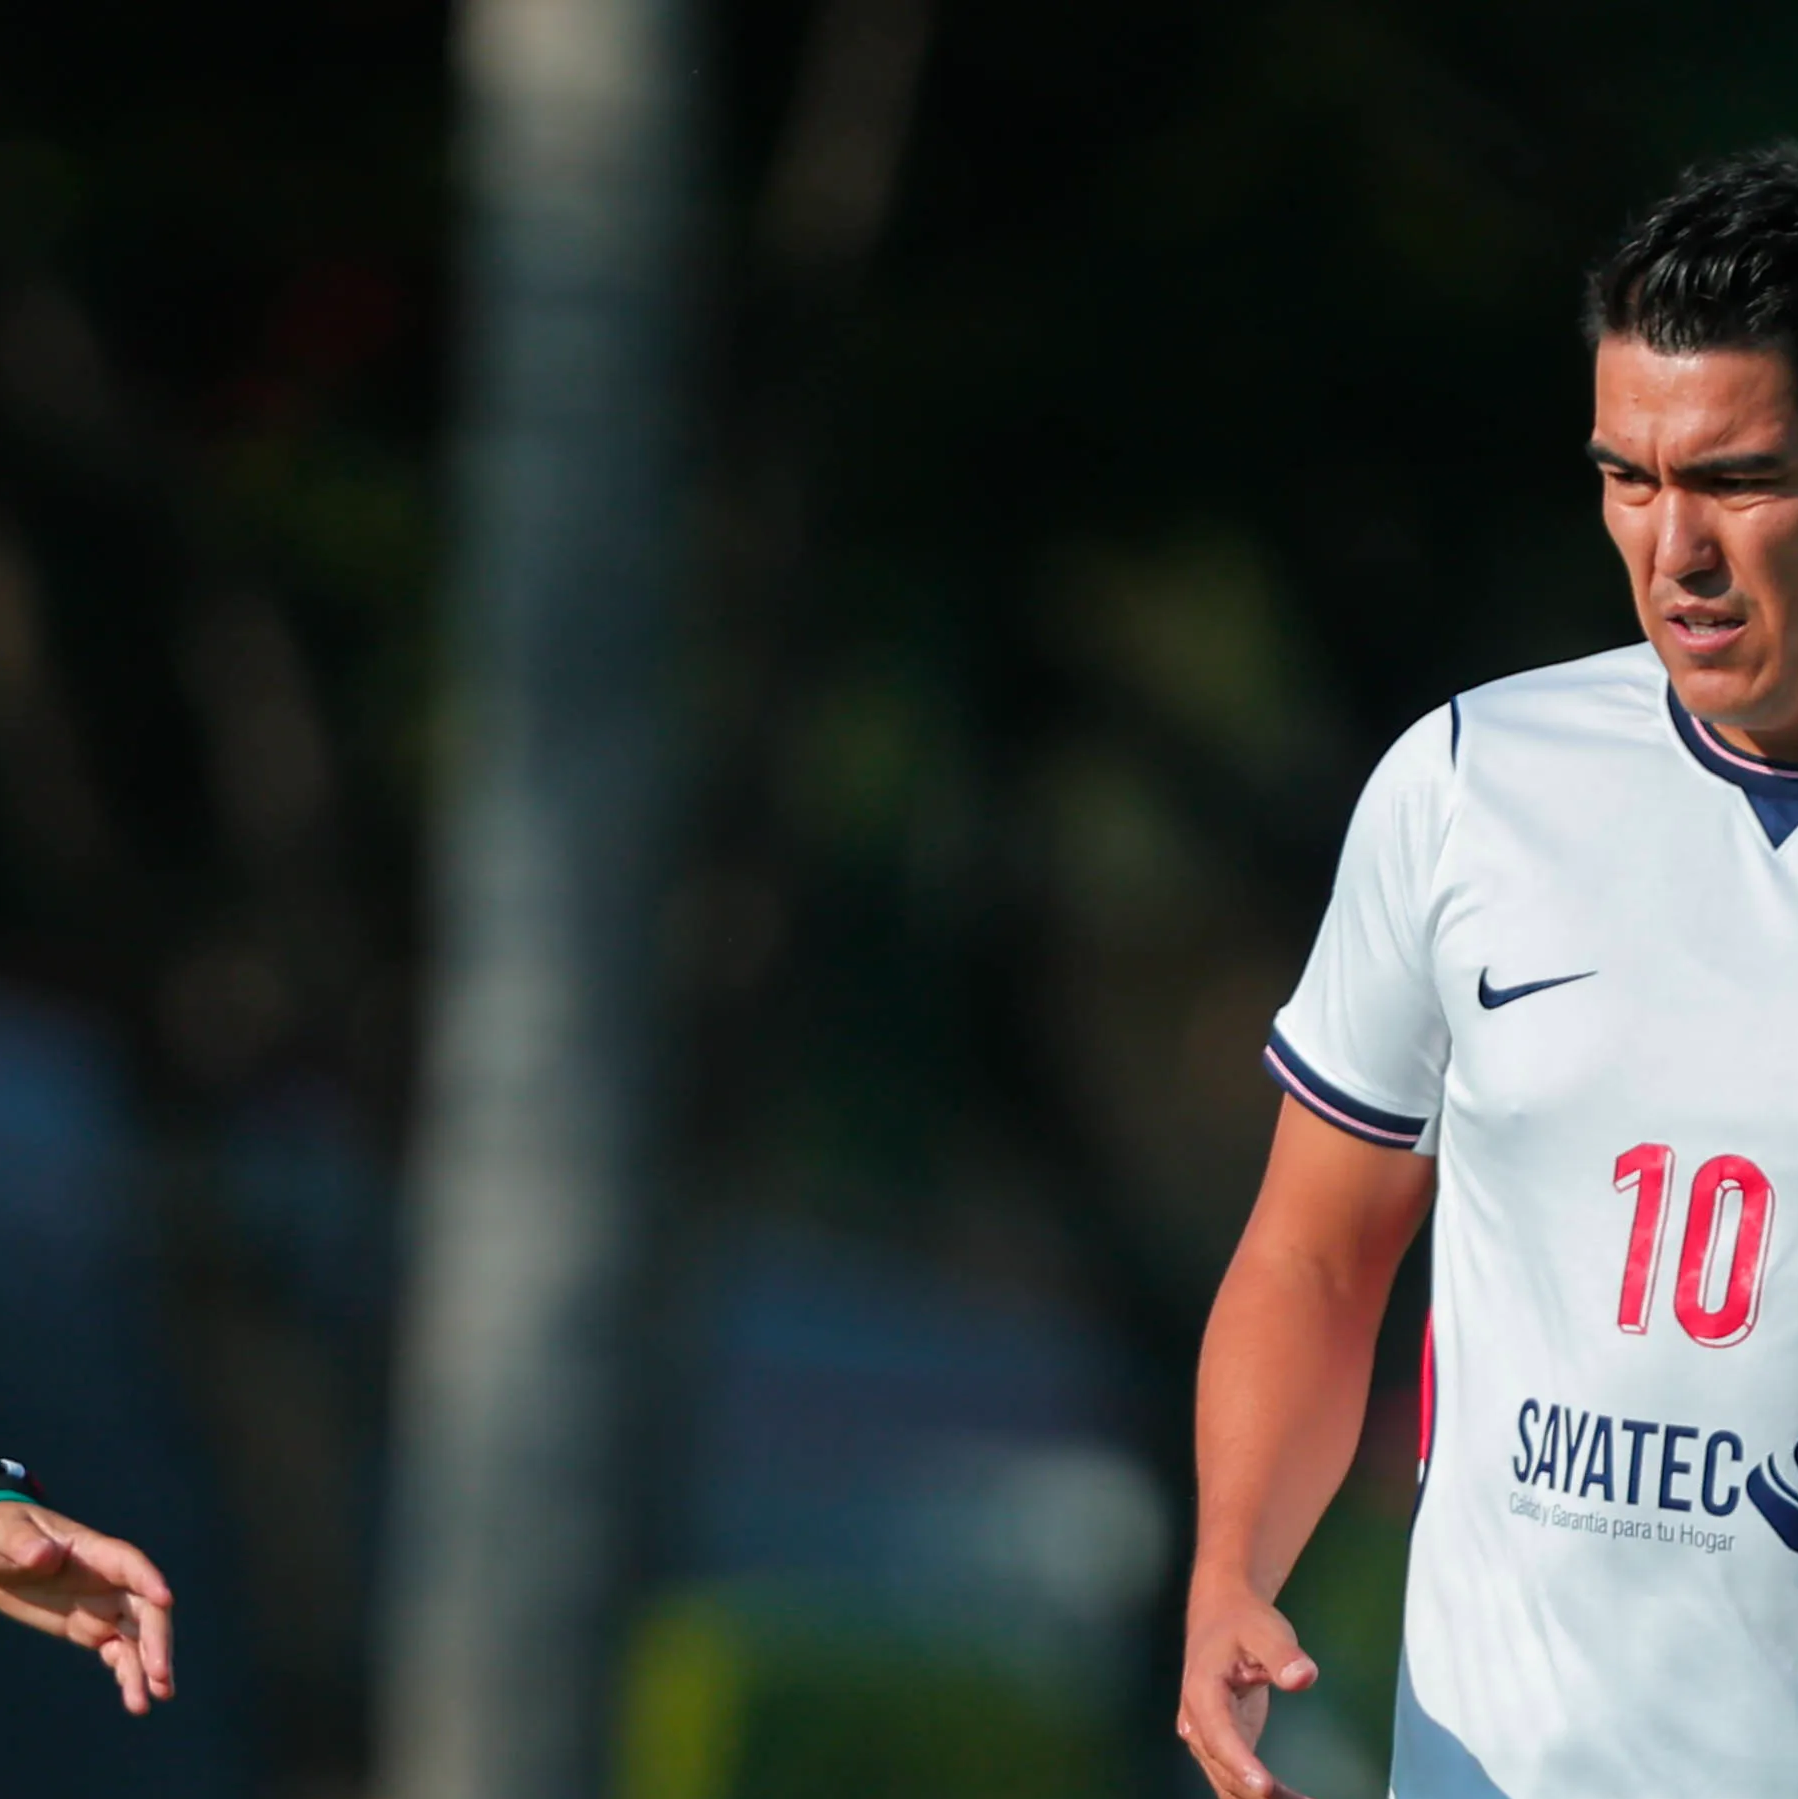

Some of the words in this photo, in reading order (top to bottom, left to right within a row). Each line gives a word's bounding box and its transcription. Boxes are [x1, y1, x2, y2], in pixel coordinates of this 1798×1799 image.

[1612, 1142, 1776, 1349] 10
[1512, 1397, 1744, 1517] SAYATEC
[1541, 1506, 1550, 1527] y
[1612, 1517, 1652, 1540] para
[1657, 1521, 1675, 1543] tu
[1680, 1523, 1736, 1554] Hogar
